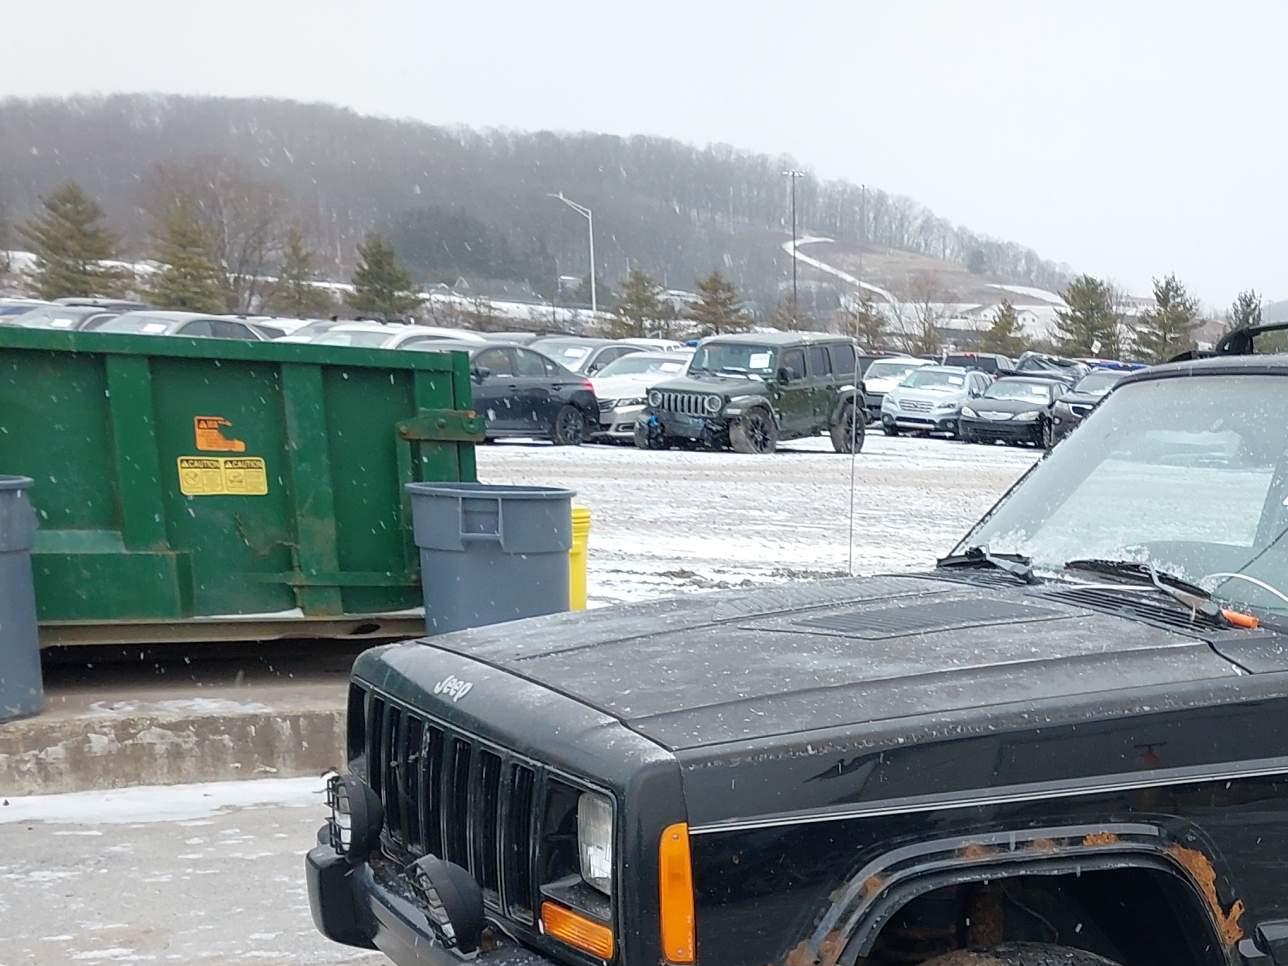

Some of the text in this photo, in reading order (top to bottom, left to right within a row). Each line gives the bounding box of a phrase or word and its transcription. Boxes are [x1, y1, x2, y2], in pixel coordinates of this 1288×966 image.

[188, 460, 220, 469] CAUTION
[232, 460, 263, 469] CAUTION
[433, 674, 473, 703] Jeep
